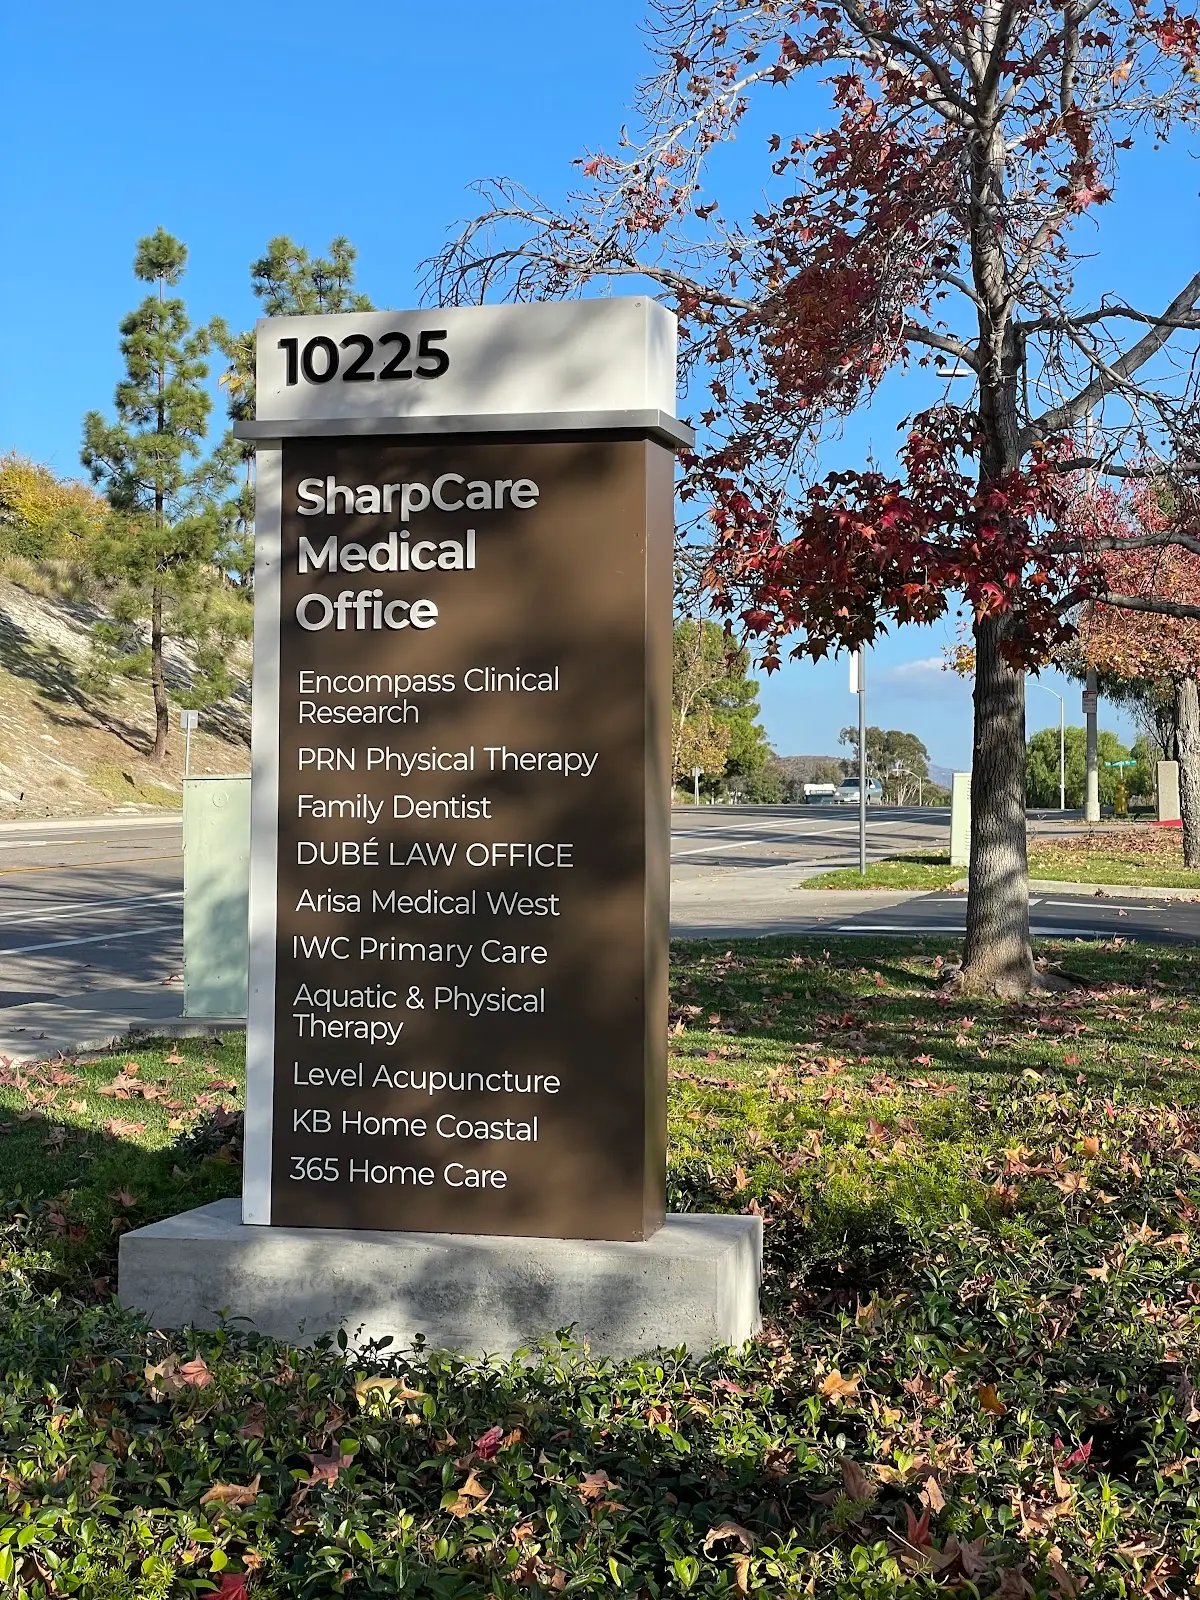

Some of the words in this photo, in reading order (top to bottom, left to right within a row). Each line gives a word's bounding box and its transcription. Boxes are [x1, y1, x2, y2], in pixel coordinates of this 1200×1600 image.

[280, 328, 450, 386] 10225
[297, 473, 539, 521] SharpCare
[298, 529, 476, 573] Medical
[296, 589, 438, 631] Office
[299, 670, 455, 698] Encompass
[464, 666, 559, 692] Clinical
[299, 699, 419, 724] Research
[298, 748, 355, 771] PRN
[367, 746, 474, 777] Physical
[483, 746, 598, 777] Therapy
[298, 794, 384, 824] Family
[393, 794, 491, 819] Dentist
[297, 837, 379, 866] DUBÉ
[389, 843, 457, 866] LAW
[465, 843, 573, 868] OFFICE
[295, 888, 361, 913] Arisa
[371, 889, 476, 915] Medical
[487, 892, 560, 916] West
[293, 936, 349, 960] IWC
[360, 936, 472, 968] Primary
[481, 940, 548, 964] Care
[293, 983, 397, 1012] Aquatic
[405, 986, 425, 1010] &
[435, 986, 545, 1017] Physical
[293, 1013, 403, 1045] Therapy
[294, 1061, 363, 1087] Level
[372, 1065, 561, 1095] Acupuncture
[293, 1108, 332, 1133] KB
[342, 1111, 426, 1137] Home
[436, 1114, 538, 1142] Coastal
[290, 1156, 339, 1181] 365
[349, 1158, 434, 1185] Home
[444, 1162, 507, 1188] Care
